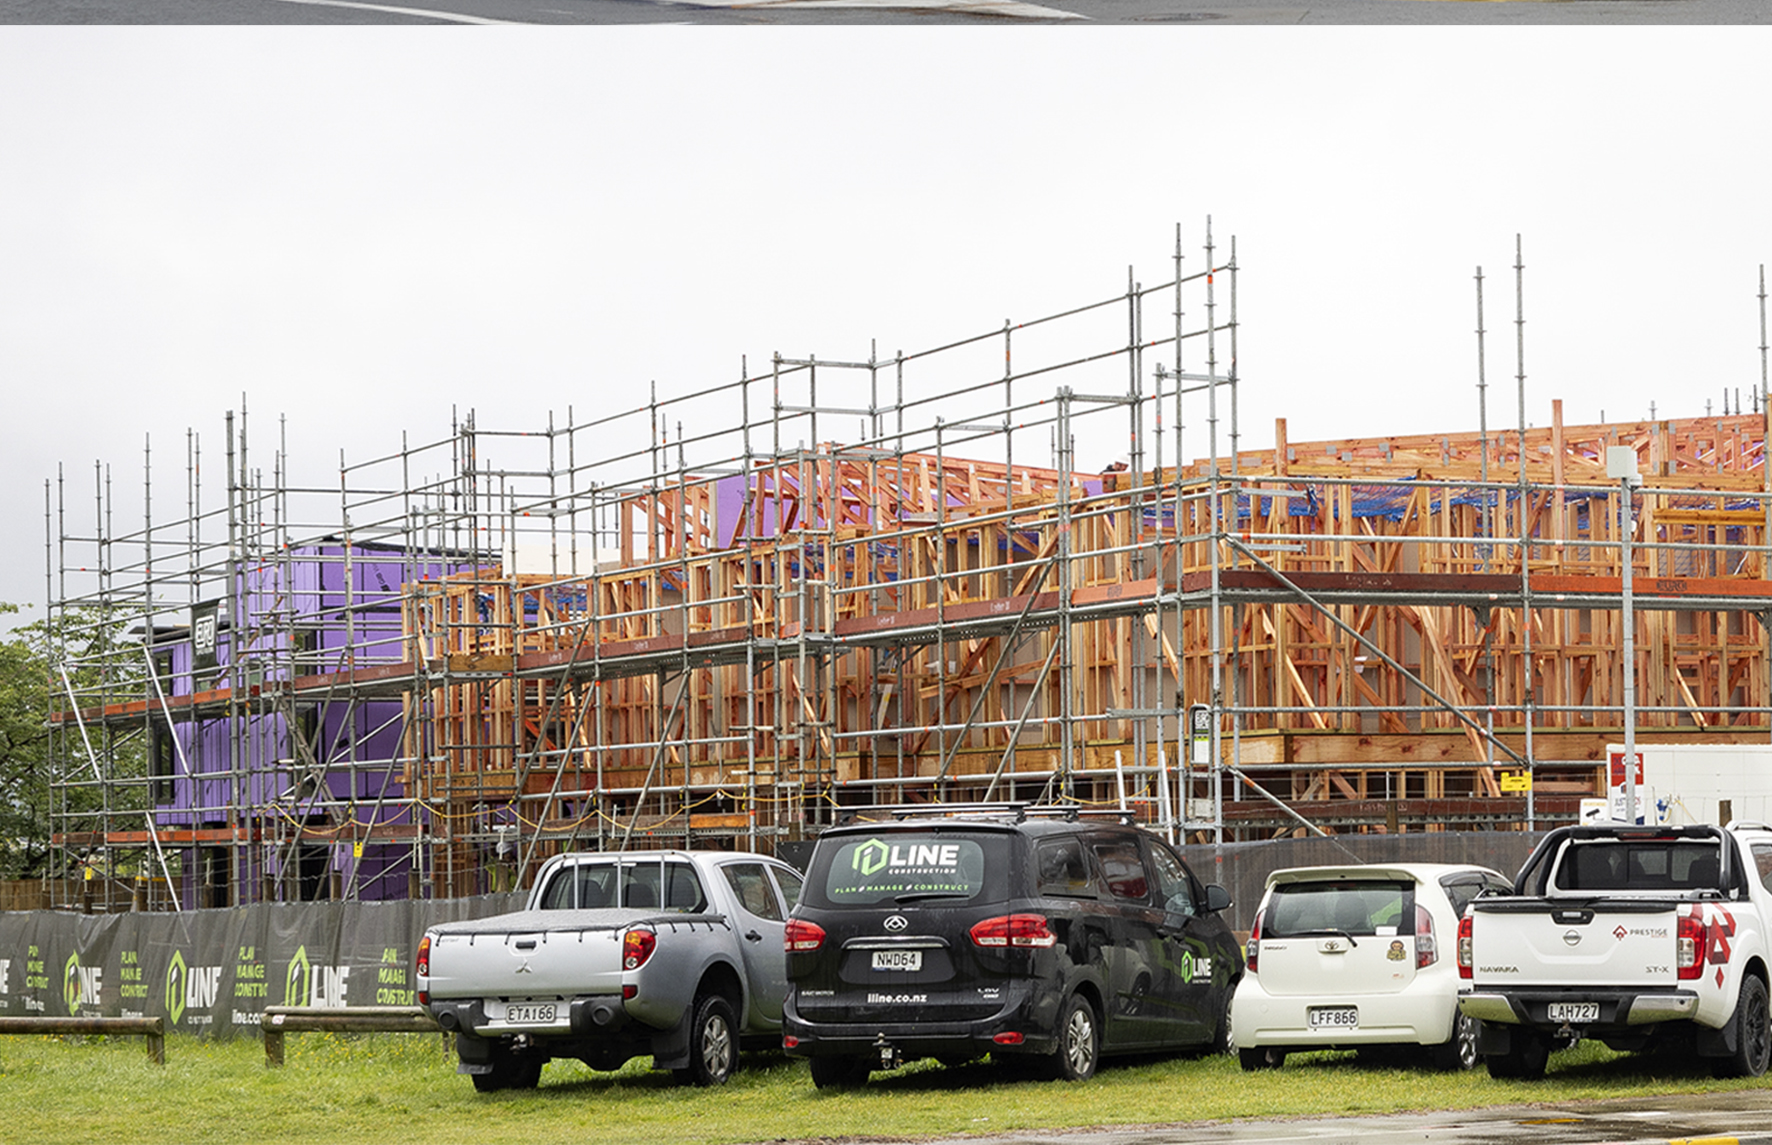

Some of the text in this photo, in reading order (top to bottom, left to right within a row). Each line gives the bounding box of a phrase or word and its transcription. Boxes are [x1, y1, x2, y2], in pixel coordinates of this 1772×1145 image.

[1629, 928, 1668, 936] PRESTIGE
[1479, 966, 1519, 974] NAVARA
[508, 1008, 553, 1021] ETA166
[1550, 1004, 1598, 1018] LAH727
[1311, 1012, 1357, 1025] LFF866
